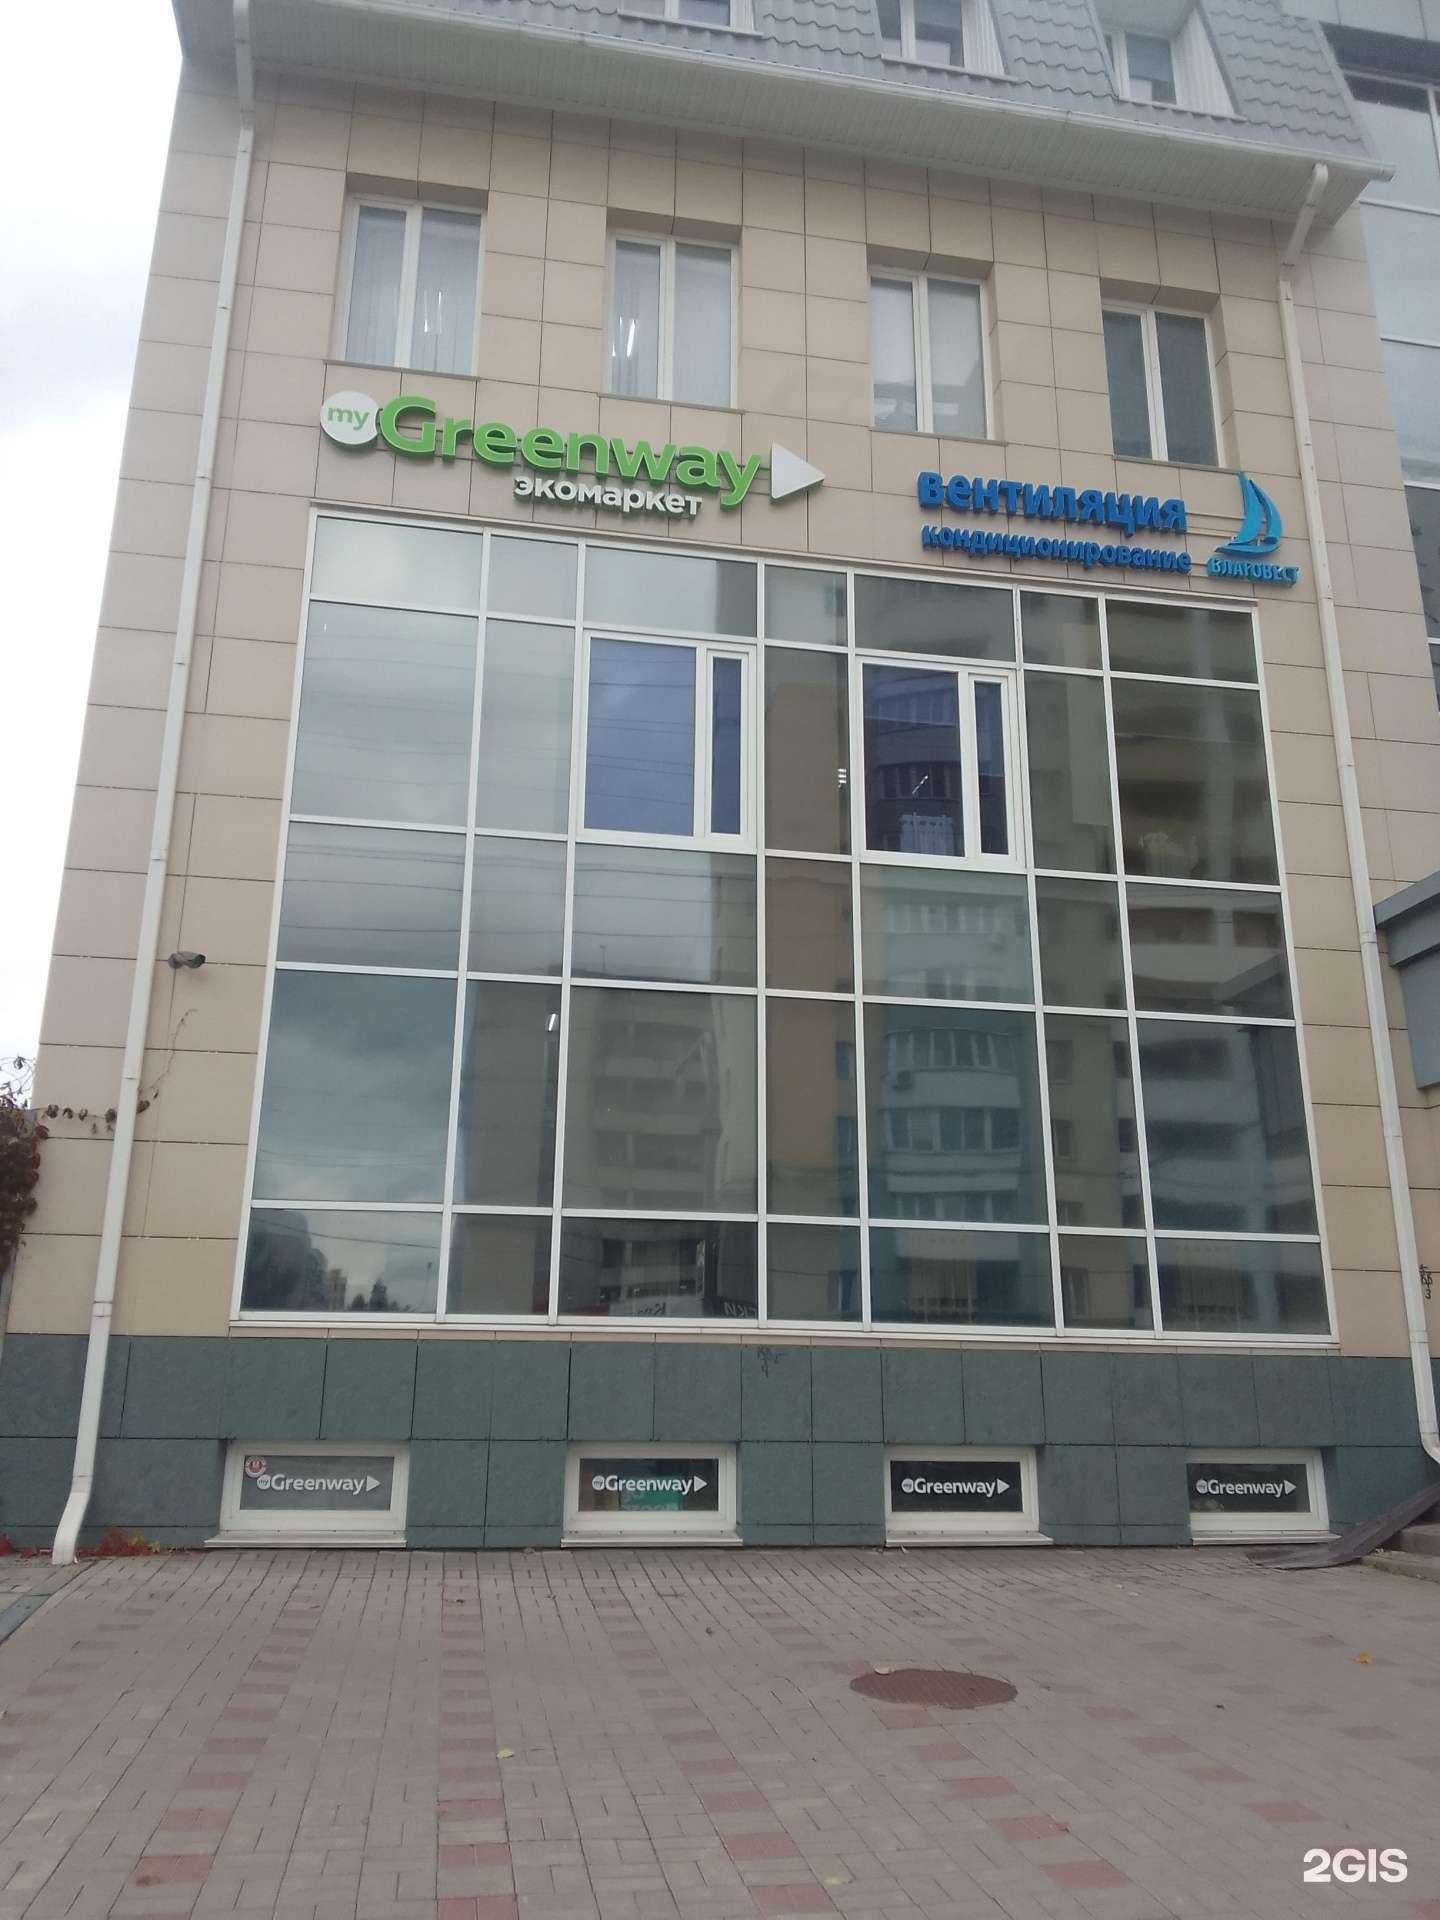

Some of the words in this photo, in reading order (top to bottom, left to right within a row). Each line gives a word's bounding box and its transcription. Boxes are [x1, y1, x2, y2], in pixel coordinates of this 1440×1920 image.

[326, 406, 370, 431] my
[379, 395, 762, 508] Greenway
[513, 476, 703, 516] экомаркет
[917, 471, 1187, 537] Вентиляция
[271, 1474, 365, 1495] Greenway
[605, 1475, 692, 1495] Greenway
[914, 1478, 995, 1497] Greenway
[1208, 1479, 1283, 1498] Greenway
